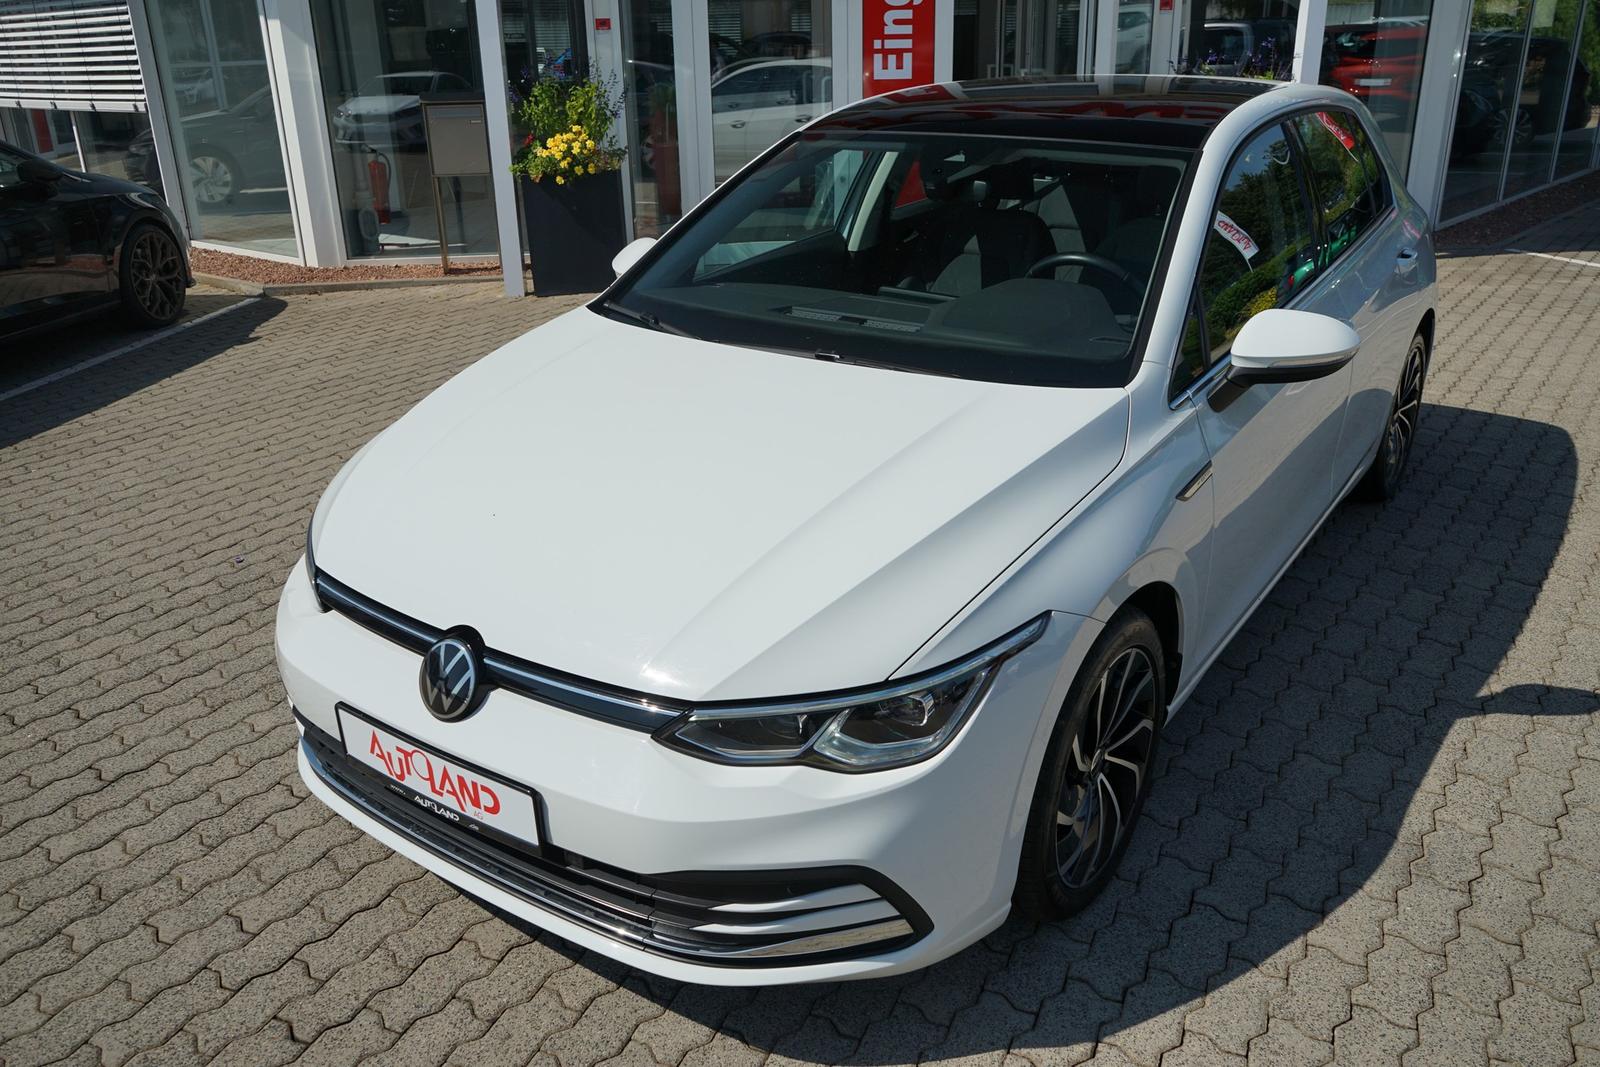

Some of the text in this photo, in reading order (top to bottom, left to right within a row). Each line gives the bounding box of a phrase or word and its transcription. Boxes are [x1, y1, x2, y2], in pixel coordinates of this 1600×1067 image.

[421, 640, 475, 718] VW
[369, 729, 501, 816] AUTOLAND
[414, 795, 460, 823] AUTOLAND
